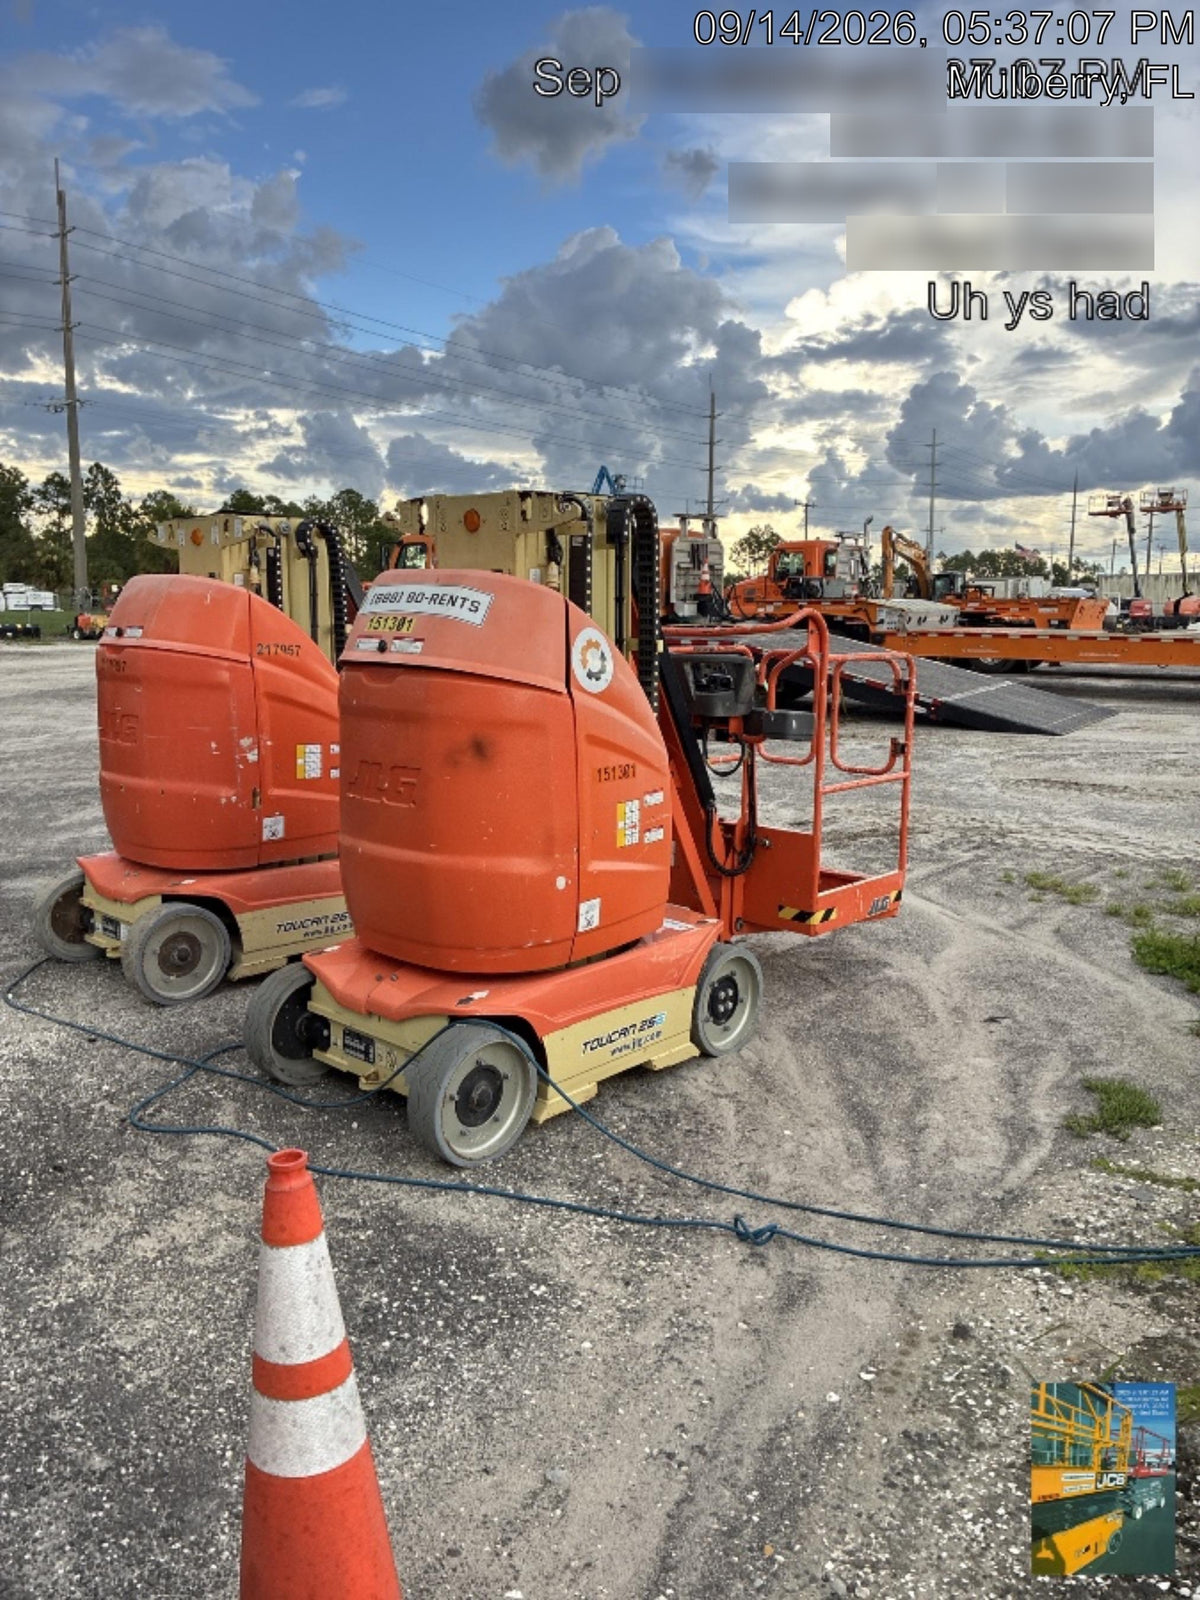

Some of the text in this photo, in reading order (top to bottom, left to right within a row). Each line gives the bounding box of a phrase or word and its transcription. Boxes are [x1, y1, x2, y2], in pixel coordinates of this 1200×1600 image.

[367, 616, 413, 632] 151301
[597, 763, 637, 782] 151301
[582, 1023, 638, 1055] TOUCAN
